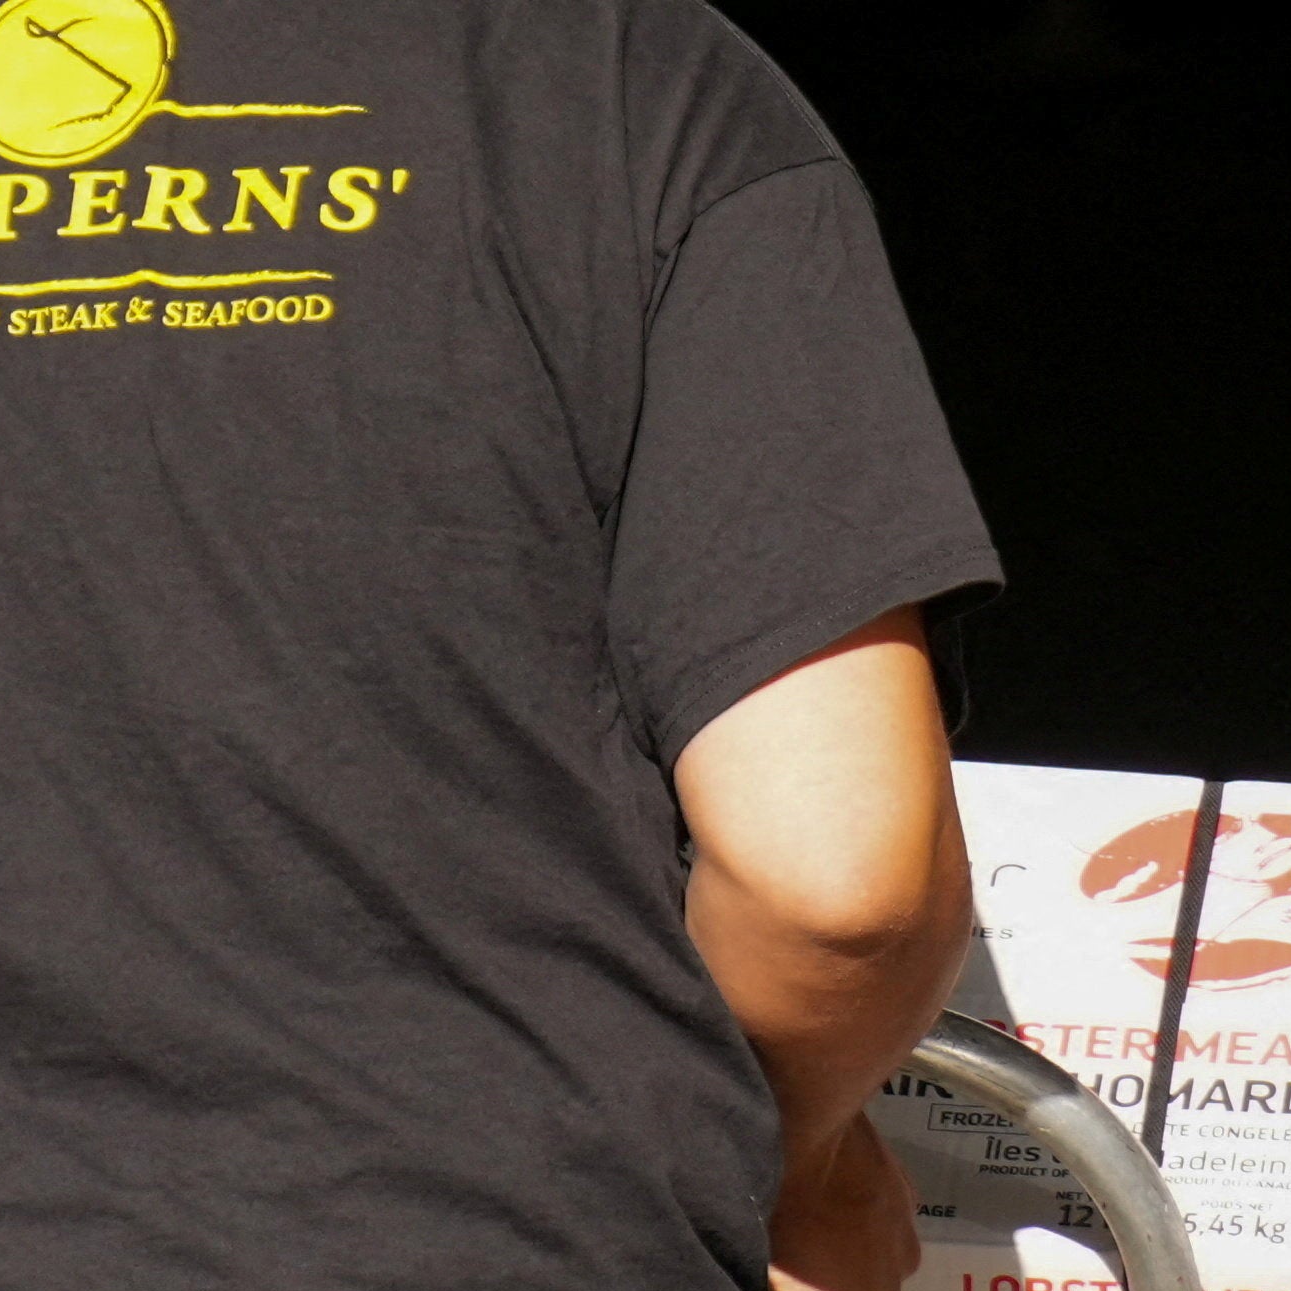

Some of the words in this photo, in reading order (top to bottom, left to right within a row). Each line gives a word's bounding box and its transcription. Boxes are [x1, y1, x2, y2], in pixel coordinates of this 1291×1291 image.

[7, 301, 118, 337] STEAK
[124, 296, 152, 322] &
[161, 293, 334, 328] SEAFOOD
[940, 1110, 1014, 1128] FROZE
[979, 1164, 1048, 1177] PRODUCT
[1056, 1190, 1082, 1201] NET
[1058, 1203, 1094, 1229] 12
[1254, 1214, 1287, 1244] kg
